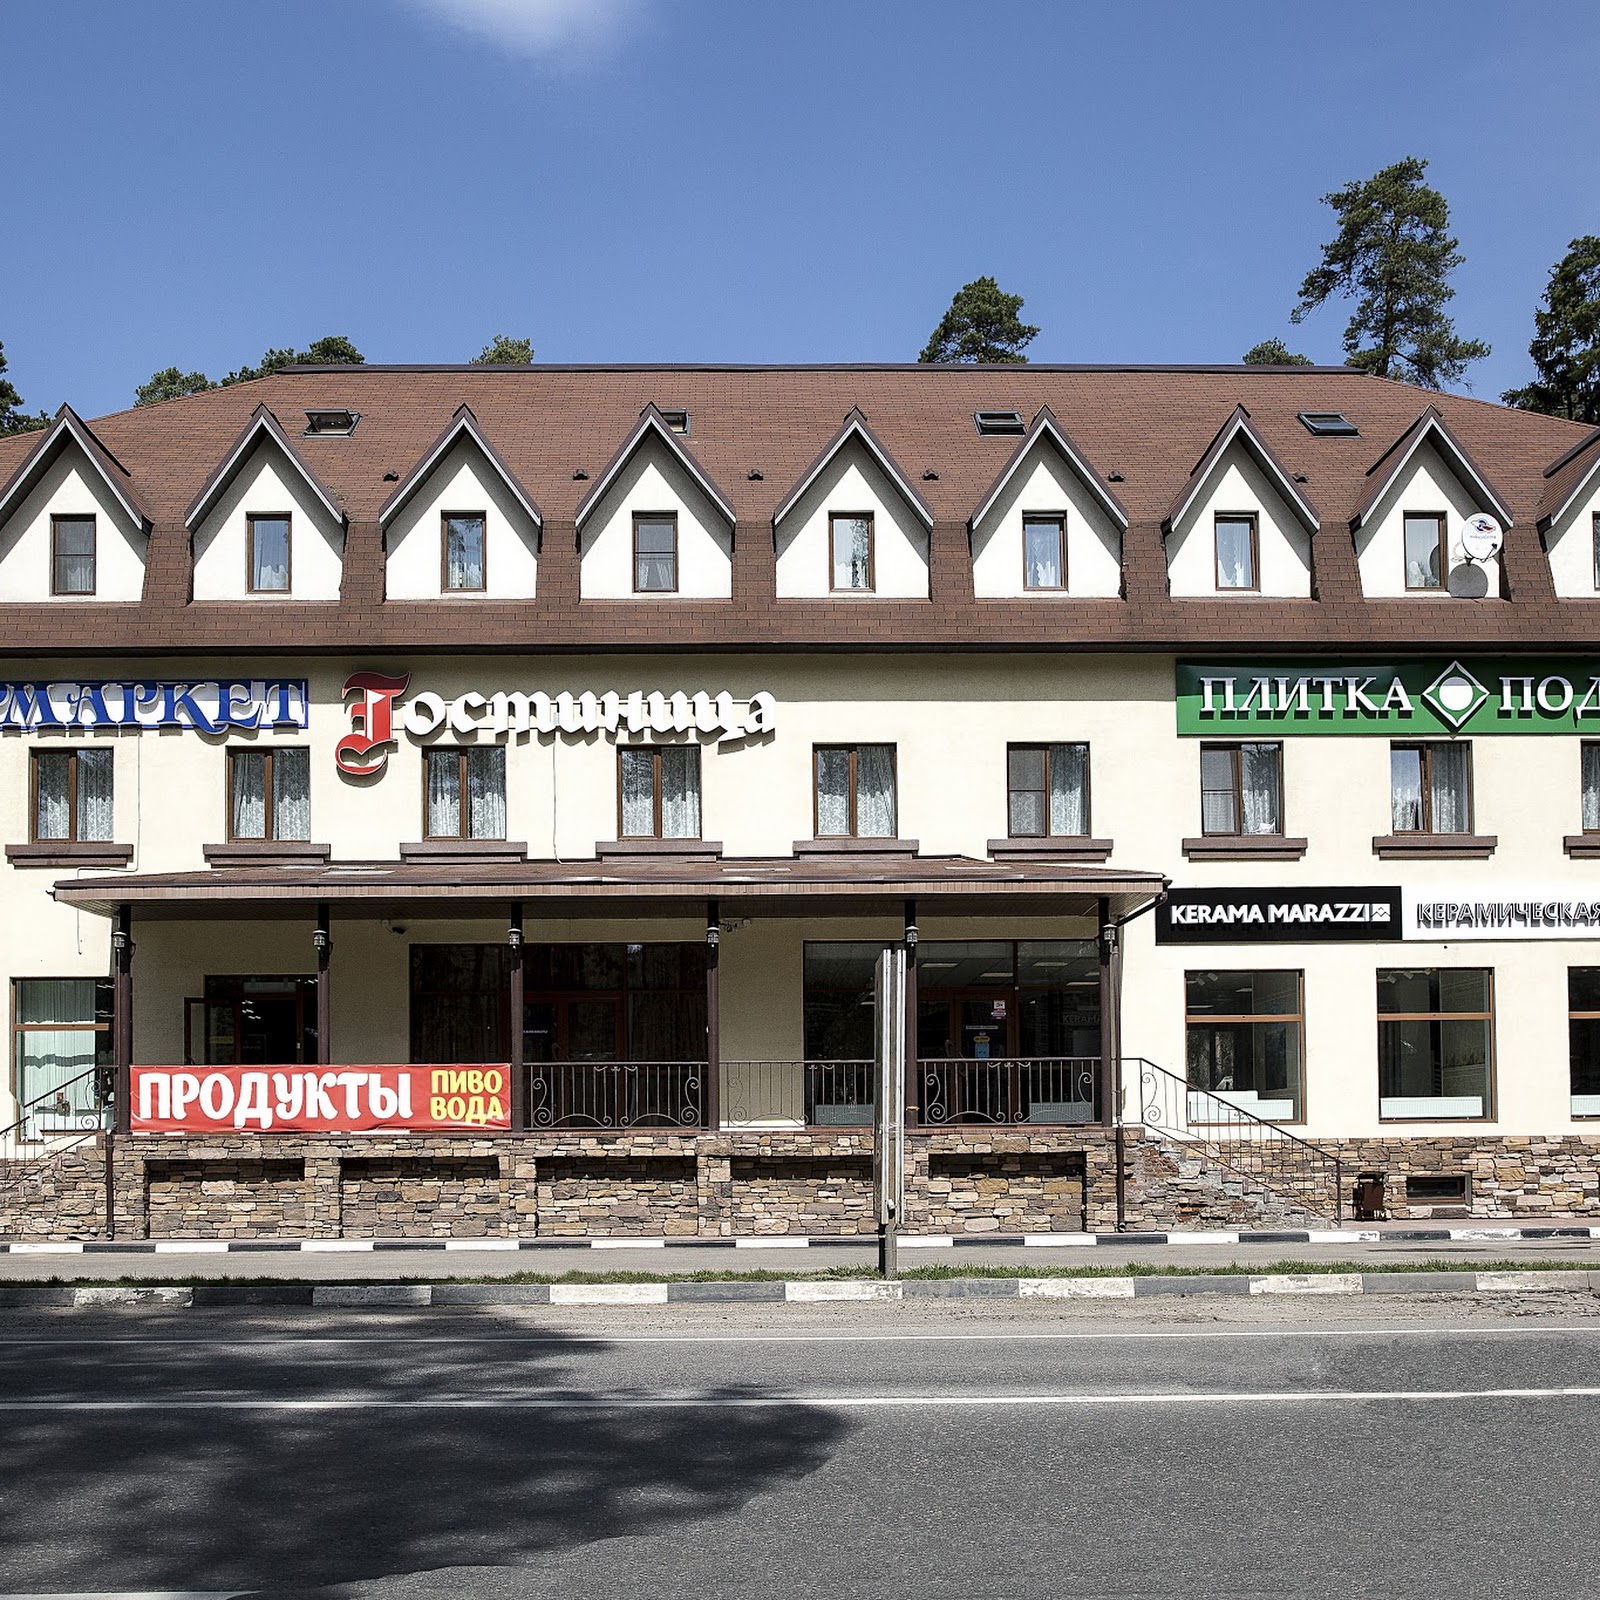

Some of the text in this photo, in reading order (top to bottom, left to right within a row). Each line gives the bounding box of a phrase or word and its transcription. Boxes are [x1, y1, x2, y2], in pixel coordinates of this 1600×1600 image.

[0, 681, 306, 735] МАРКЕТ
[1200, 676, 1416, 713] ПЛИТКА
[335, 671, 776, 775] Гостиница
[1171, 903, 1370, 925] KERAMA MARAZZI
[1417, 902, 1600, 922] КЕРАМИЧЕСКАЯ
[431, 1069, 502, 1095] ПИВО
[138, 1071, 413, 1129] ПРОДУКТЫ
[430, 1096, 504, 1125] ВОДА
